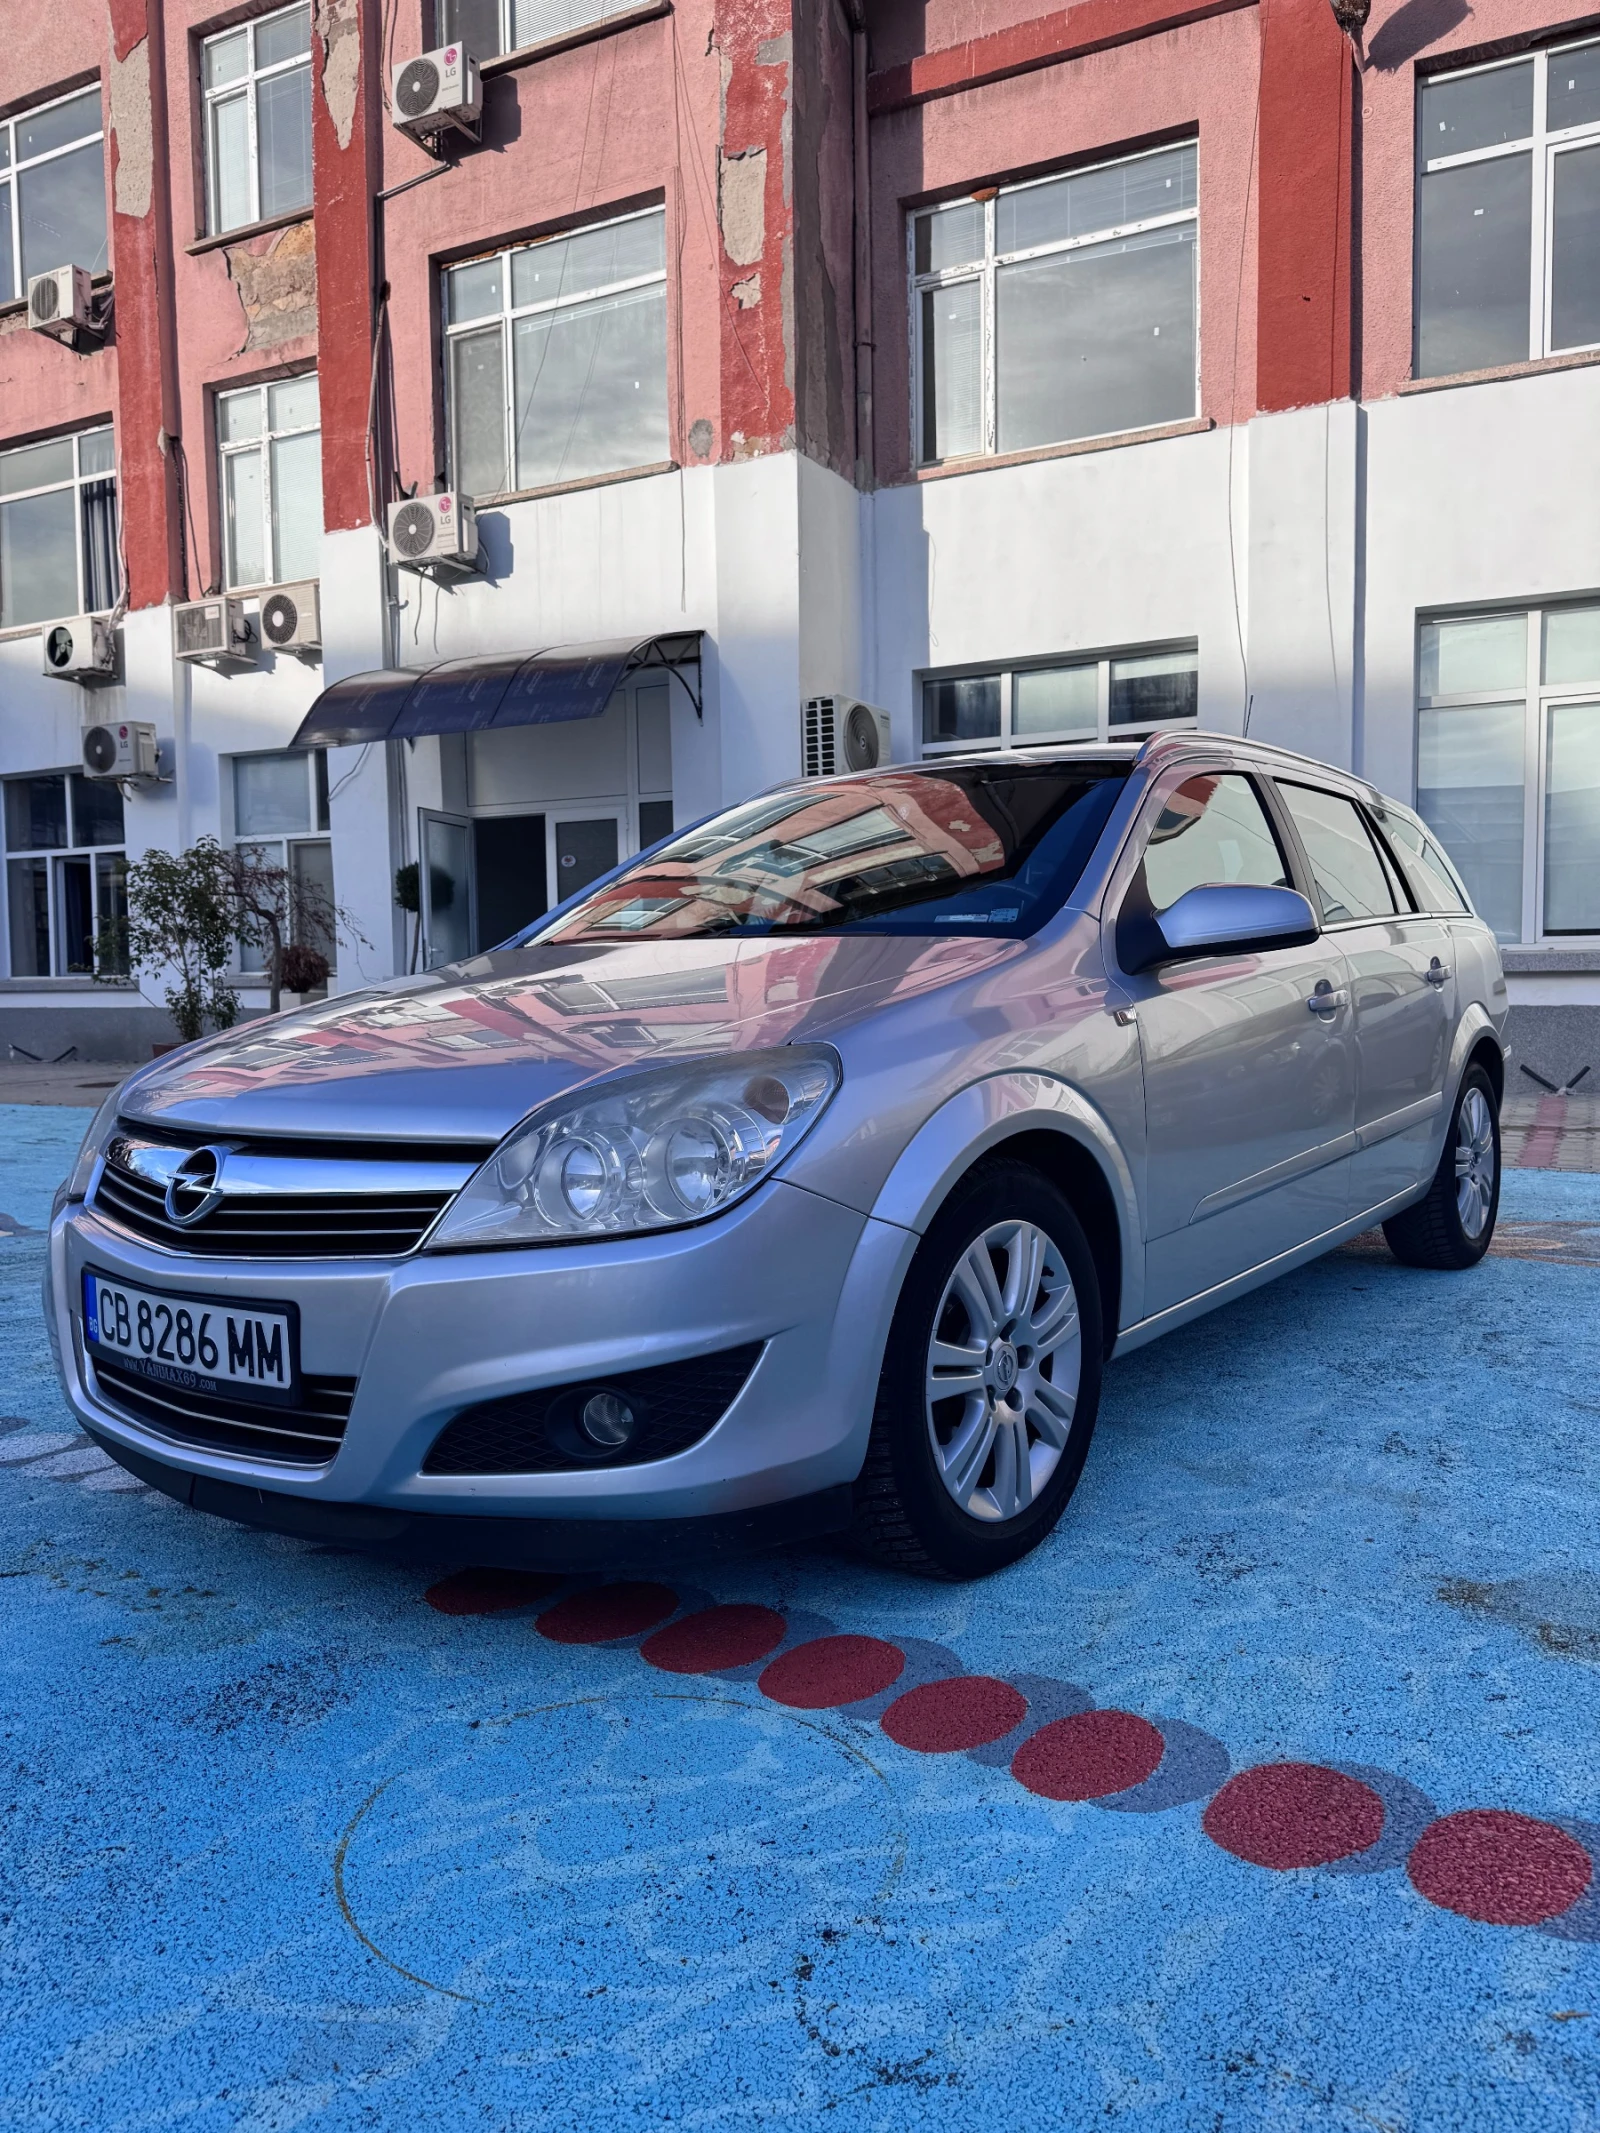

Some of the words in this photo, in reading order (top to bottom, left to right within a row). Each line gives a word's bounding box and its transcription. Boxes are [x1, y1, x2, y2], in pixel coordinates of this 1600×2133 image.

[445, 67, 457, 78] LG
[440, 515, 451, 525] LG
[120, 741, 129, 749] LG
[88, 1315, 98, 1334] BG
[100, 1287, 131, 1347] CB
[137, 1299, 219, 1370] 8286
[226, 1316, 284, 1382] MM
